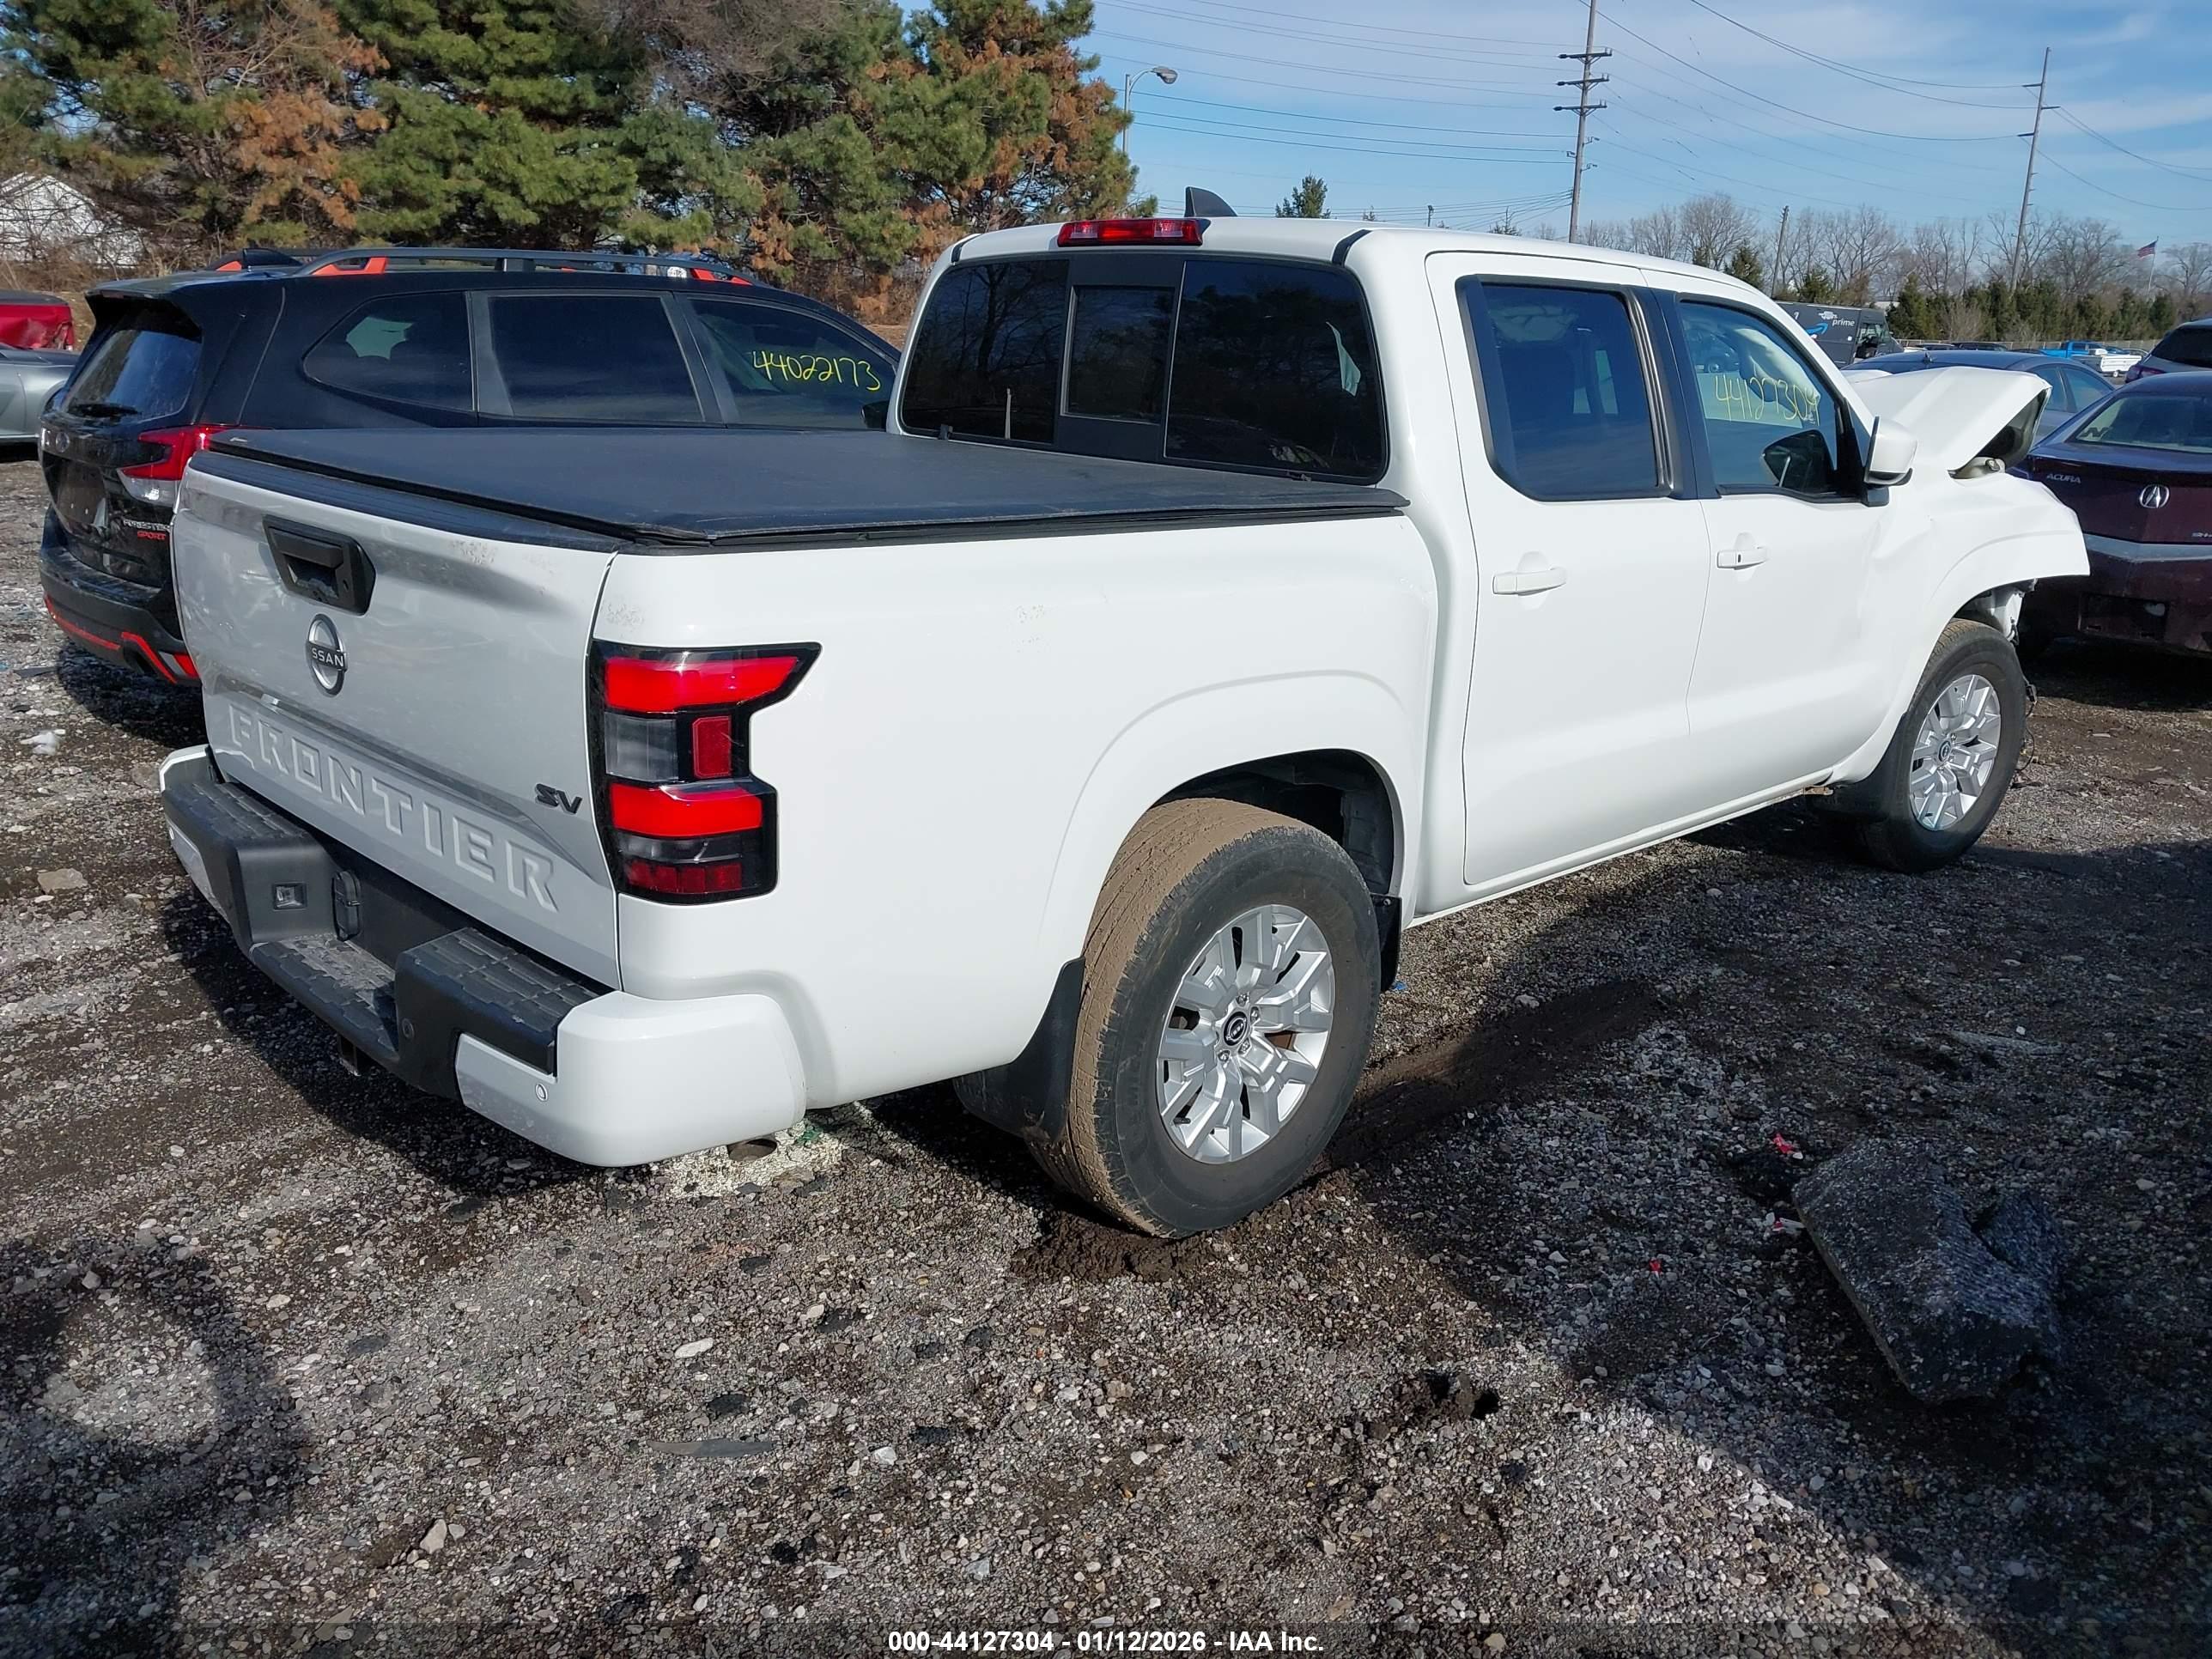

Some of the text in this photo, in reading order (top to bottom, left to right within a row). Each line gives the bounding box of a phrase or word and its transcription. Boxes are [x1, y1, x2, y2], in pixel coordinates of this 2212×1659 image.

[1832, 319, 1856, 327] prime
[752, 350, 881, 391] 44022173
[1716, 374, 1820, 427] 44127304
[2046, 473, 2081, 484] ACURA
[137, 531, 167, 540] SPORT
[310, 647, 344, 667] SSAN
[229, 702, 560, 913] FRONTIER
[535, 782, 583, 815] SV
